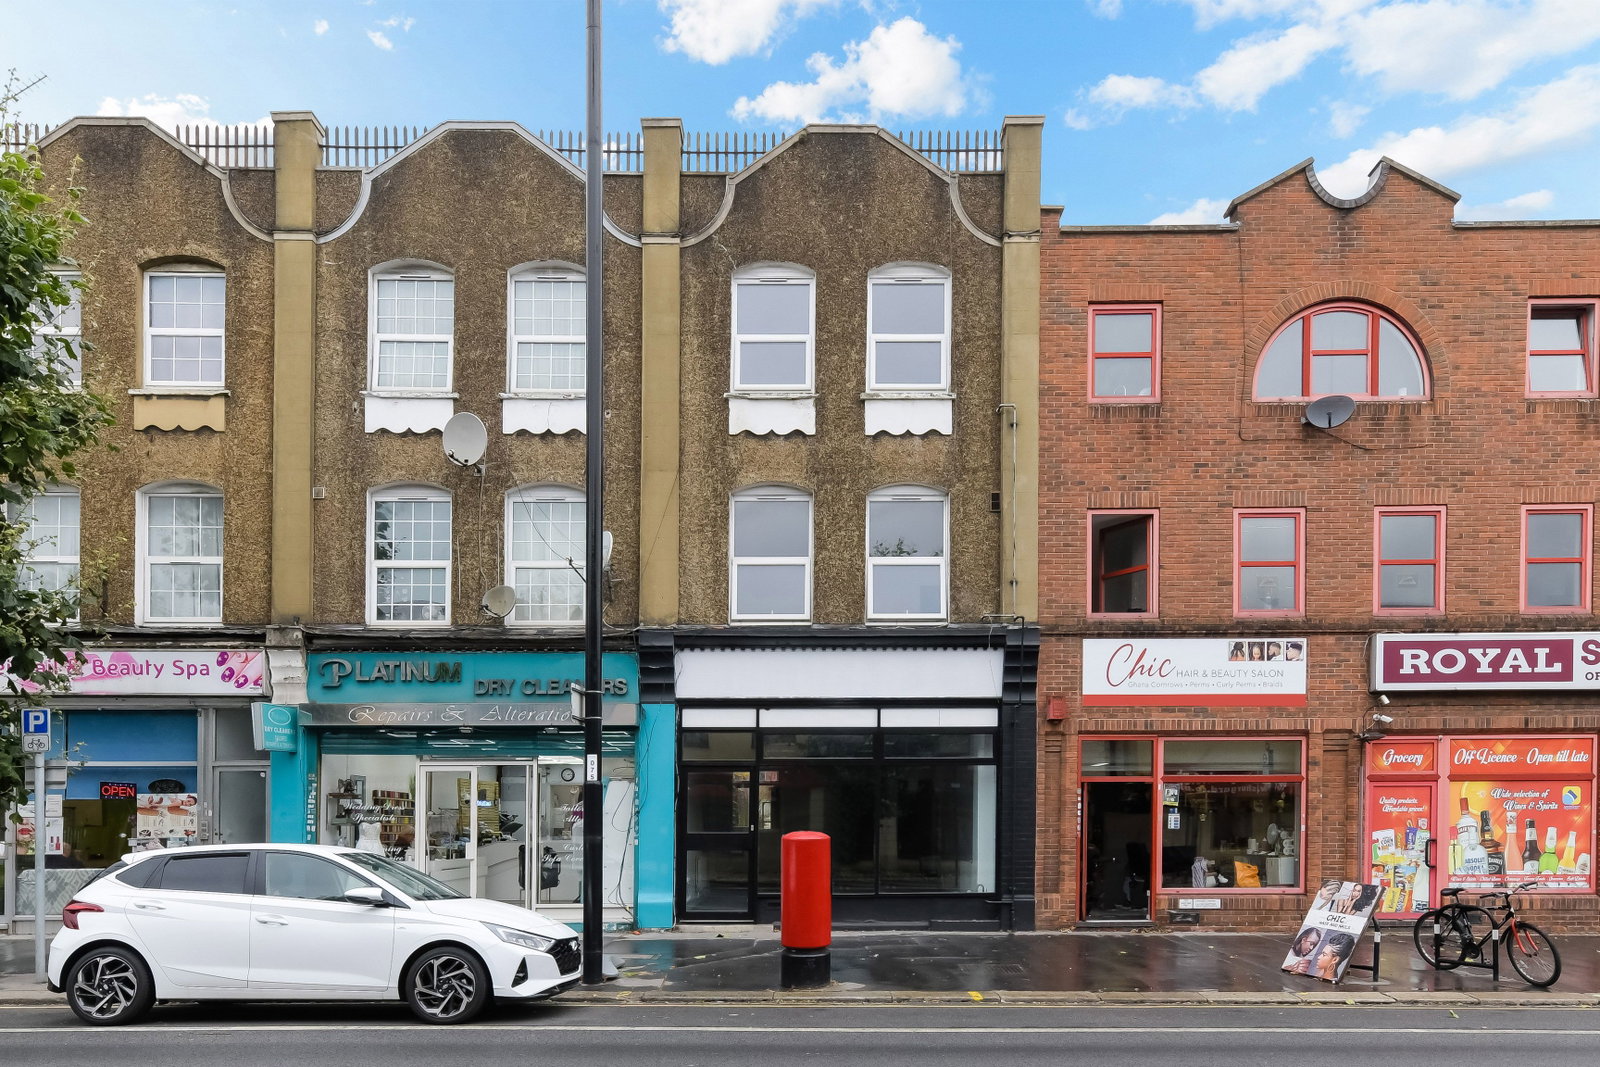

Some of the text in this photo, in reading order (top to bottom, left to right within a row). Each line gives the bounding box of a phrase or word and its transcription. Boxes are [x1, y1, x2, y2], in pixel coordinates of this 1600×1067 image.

[92, 659, 164, 678] Beauty
[173, 660, 210, 679] Spa
[1106, 643, 1284, 687] Chic HAIR & BEAUTY SALON
[1399, 647, 1562, 674] ROYAL
[320, 658, 629, 696] PLATINUM DRY CLEARS
[29, 711, 45, 733] P
[348, 705, 574, 723] Repairs & Alteratio
[1382, 749, 1424, 766] Grocery
[1454, 748, 1476, 765] Off
[1476, 747, 1518, 764] Licence
[1526, 747, 1553, 765] Open
[1556, 750, 1570, 763] till
[1571, 750, 1589, 762] late
[101, 785, 135, 797] OPEN
[1490, 788, 1550, 798] Wide selection of
[1503, 800, 1558, 811] Wines & Spirits
[1326, 914, 1346, 923] CHIC
